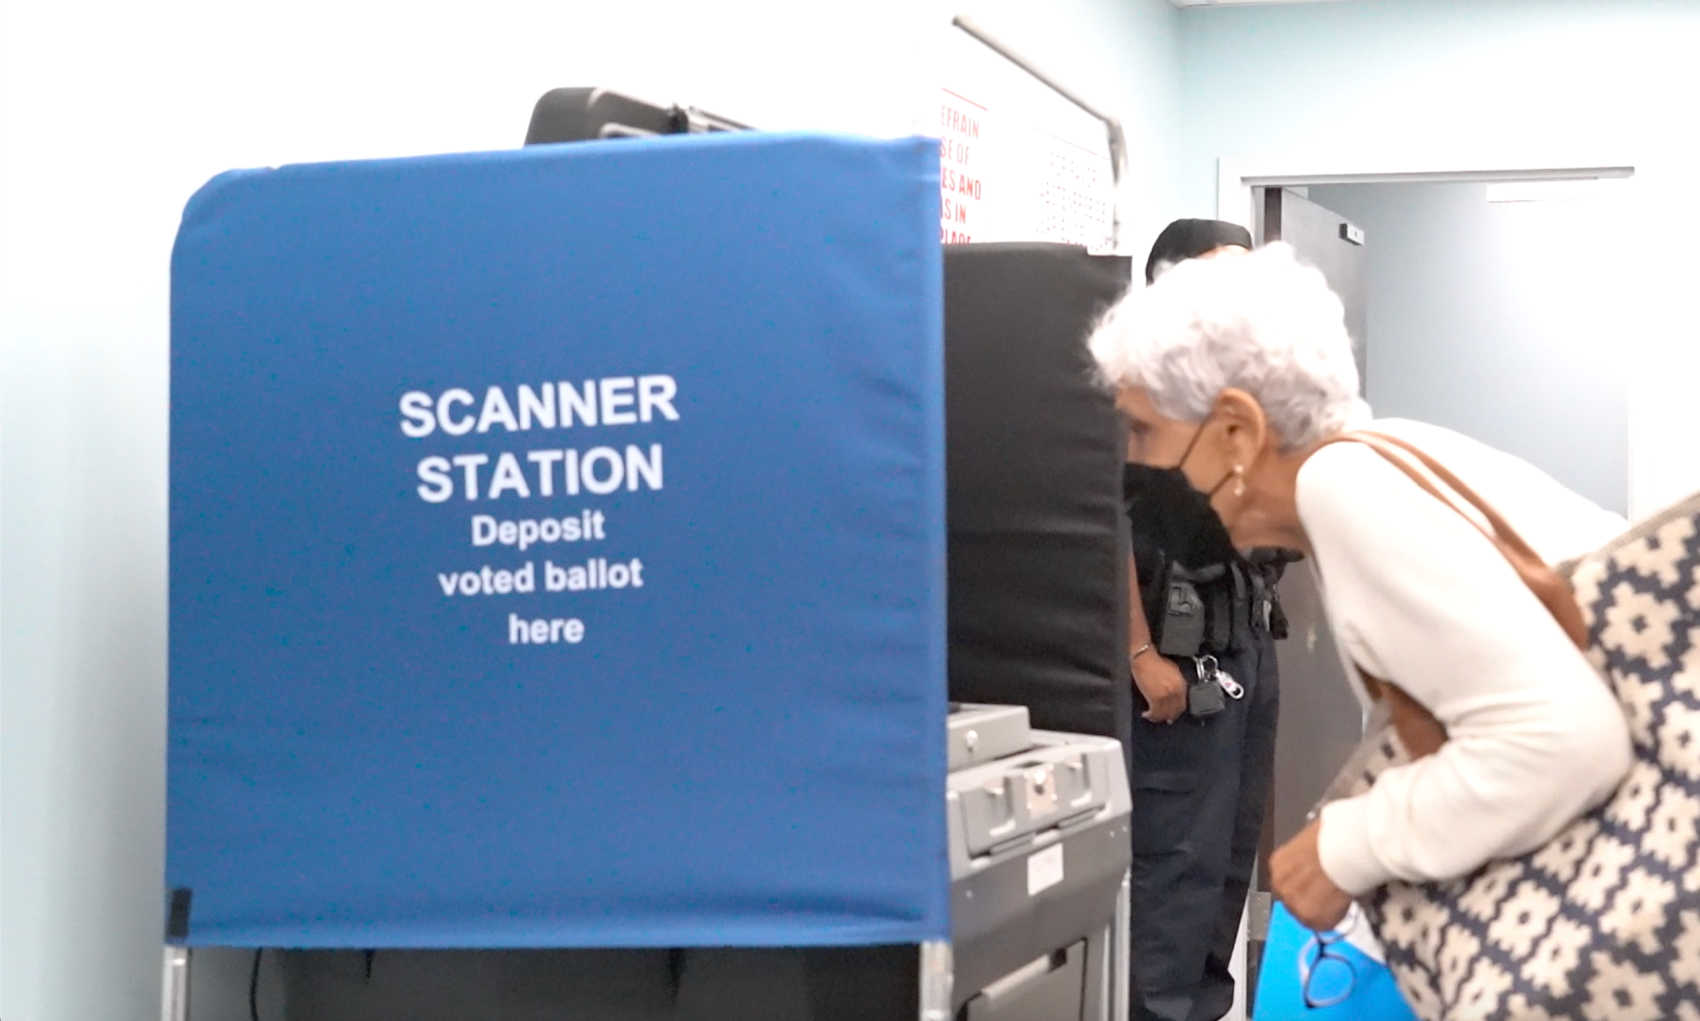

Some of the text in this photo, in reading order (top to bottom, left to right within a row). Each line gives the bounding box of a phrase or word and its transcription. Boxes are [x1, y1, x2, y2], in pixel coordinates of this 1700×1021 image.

[958, 174, 981, 200] AND
[955, 200, 966, 224] IN
[399, 374, 680, 438] SCANNER
[417, 443, 663, 503] STATION
[471, 509, 605, 551] Deposit
[438, 558, 643, 596] voted ballot
[508, 613, 585, 644] here
